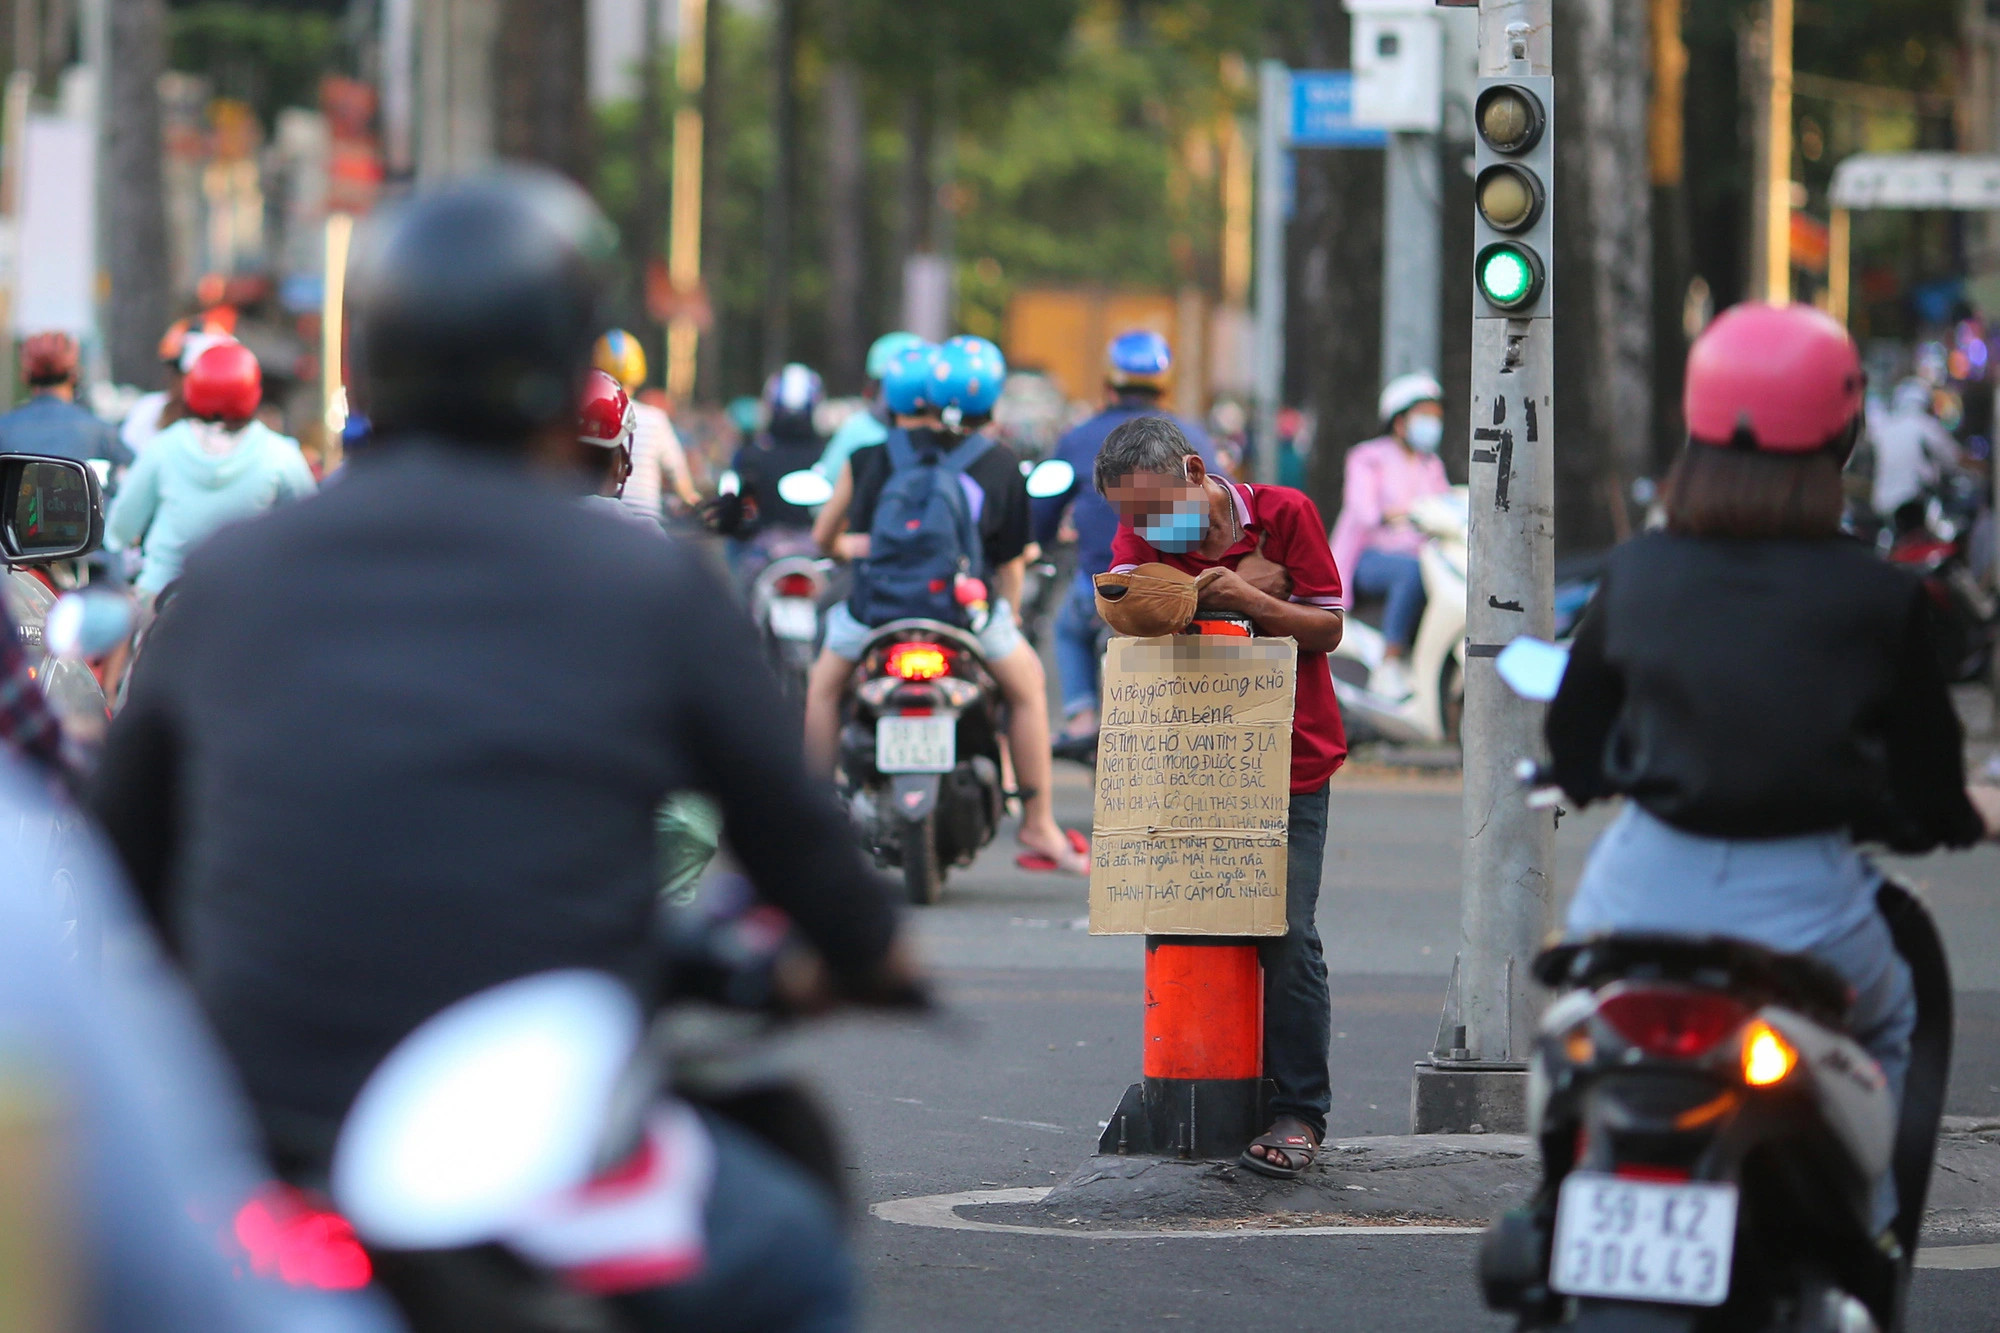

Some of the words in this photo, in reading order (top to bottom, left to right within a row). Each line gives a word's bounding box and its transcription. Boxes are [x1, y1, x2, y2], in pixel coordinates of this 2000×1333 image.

[1185, 734, 1215, 752] VAN
[1242, 732, 1254, 752] 3
[1104, 797, 1126, 812] ANH
[1107, 879, 1144, 902] THÀNH
